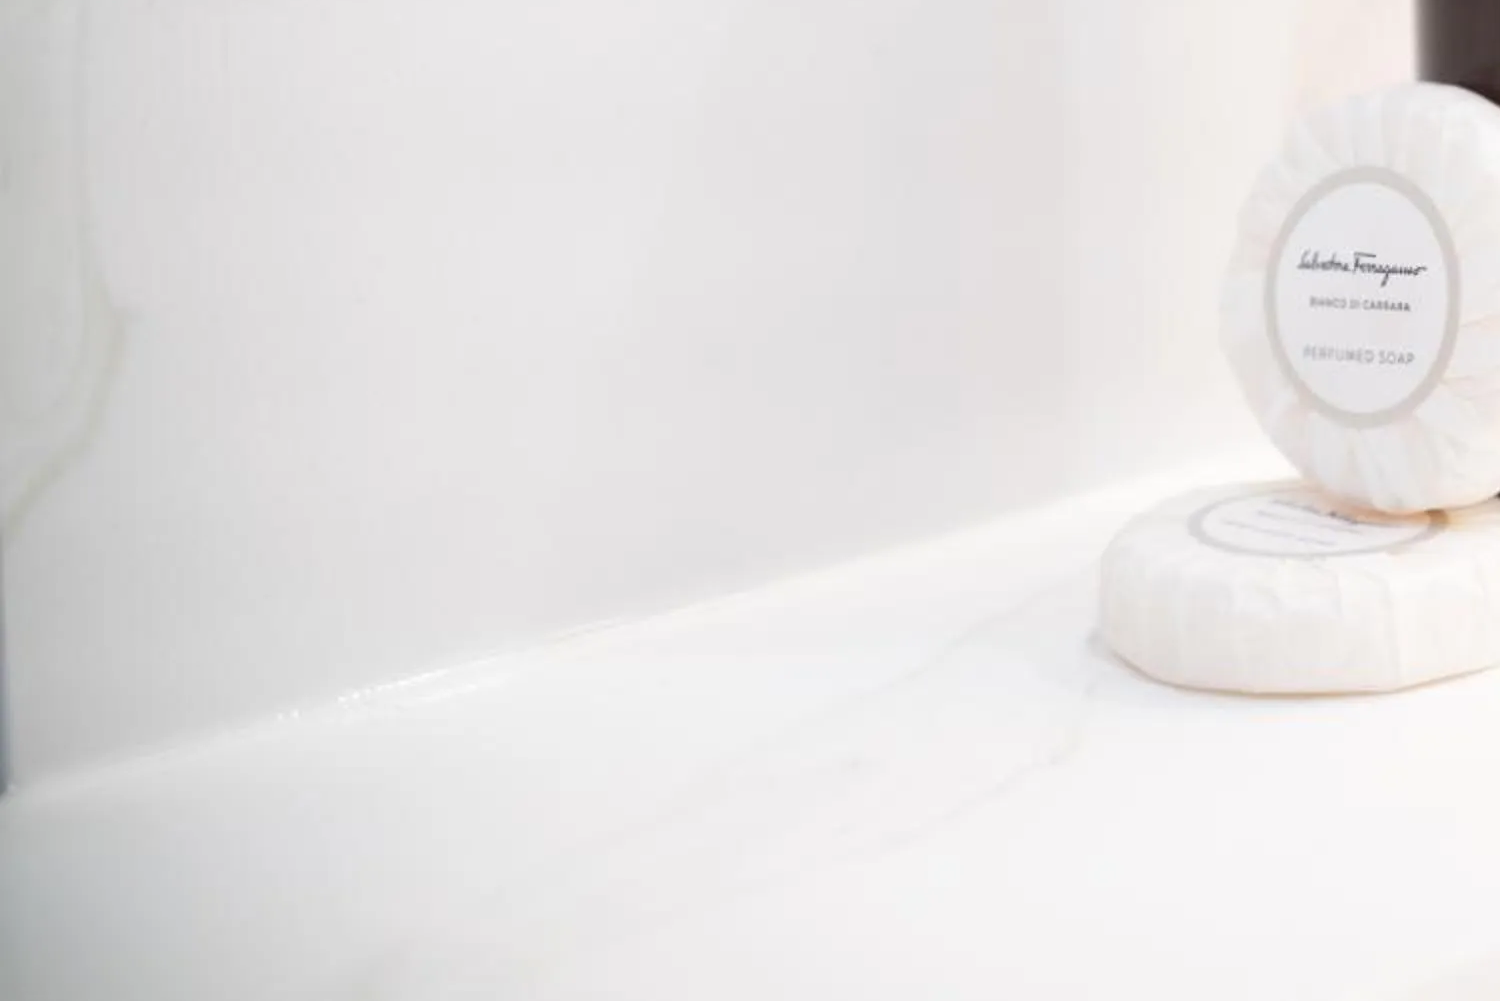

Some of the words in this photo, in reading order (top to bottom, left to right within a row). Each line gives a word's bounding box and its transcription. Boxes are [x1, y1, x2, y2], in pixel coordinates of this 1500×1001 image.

[1296, 249, 1351, 272] Salvatore
[1352, 251, 1428, 288] Ferragamo
[1308, 296, 1347, 310] BIANCO
[1348, 298, 1361, 310] DI
[1362, 299, 1412, 313] CARRARA
[1302, 343, 1375, 365] PERFUMED
[1378, 349, 1416, 366] SOAP
